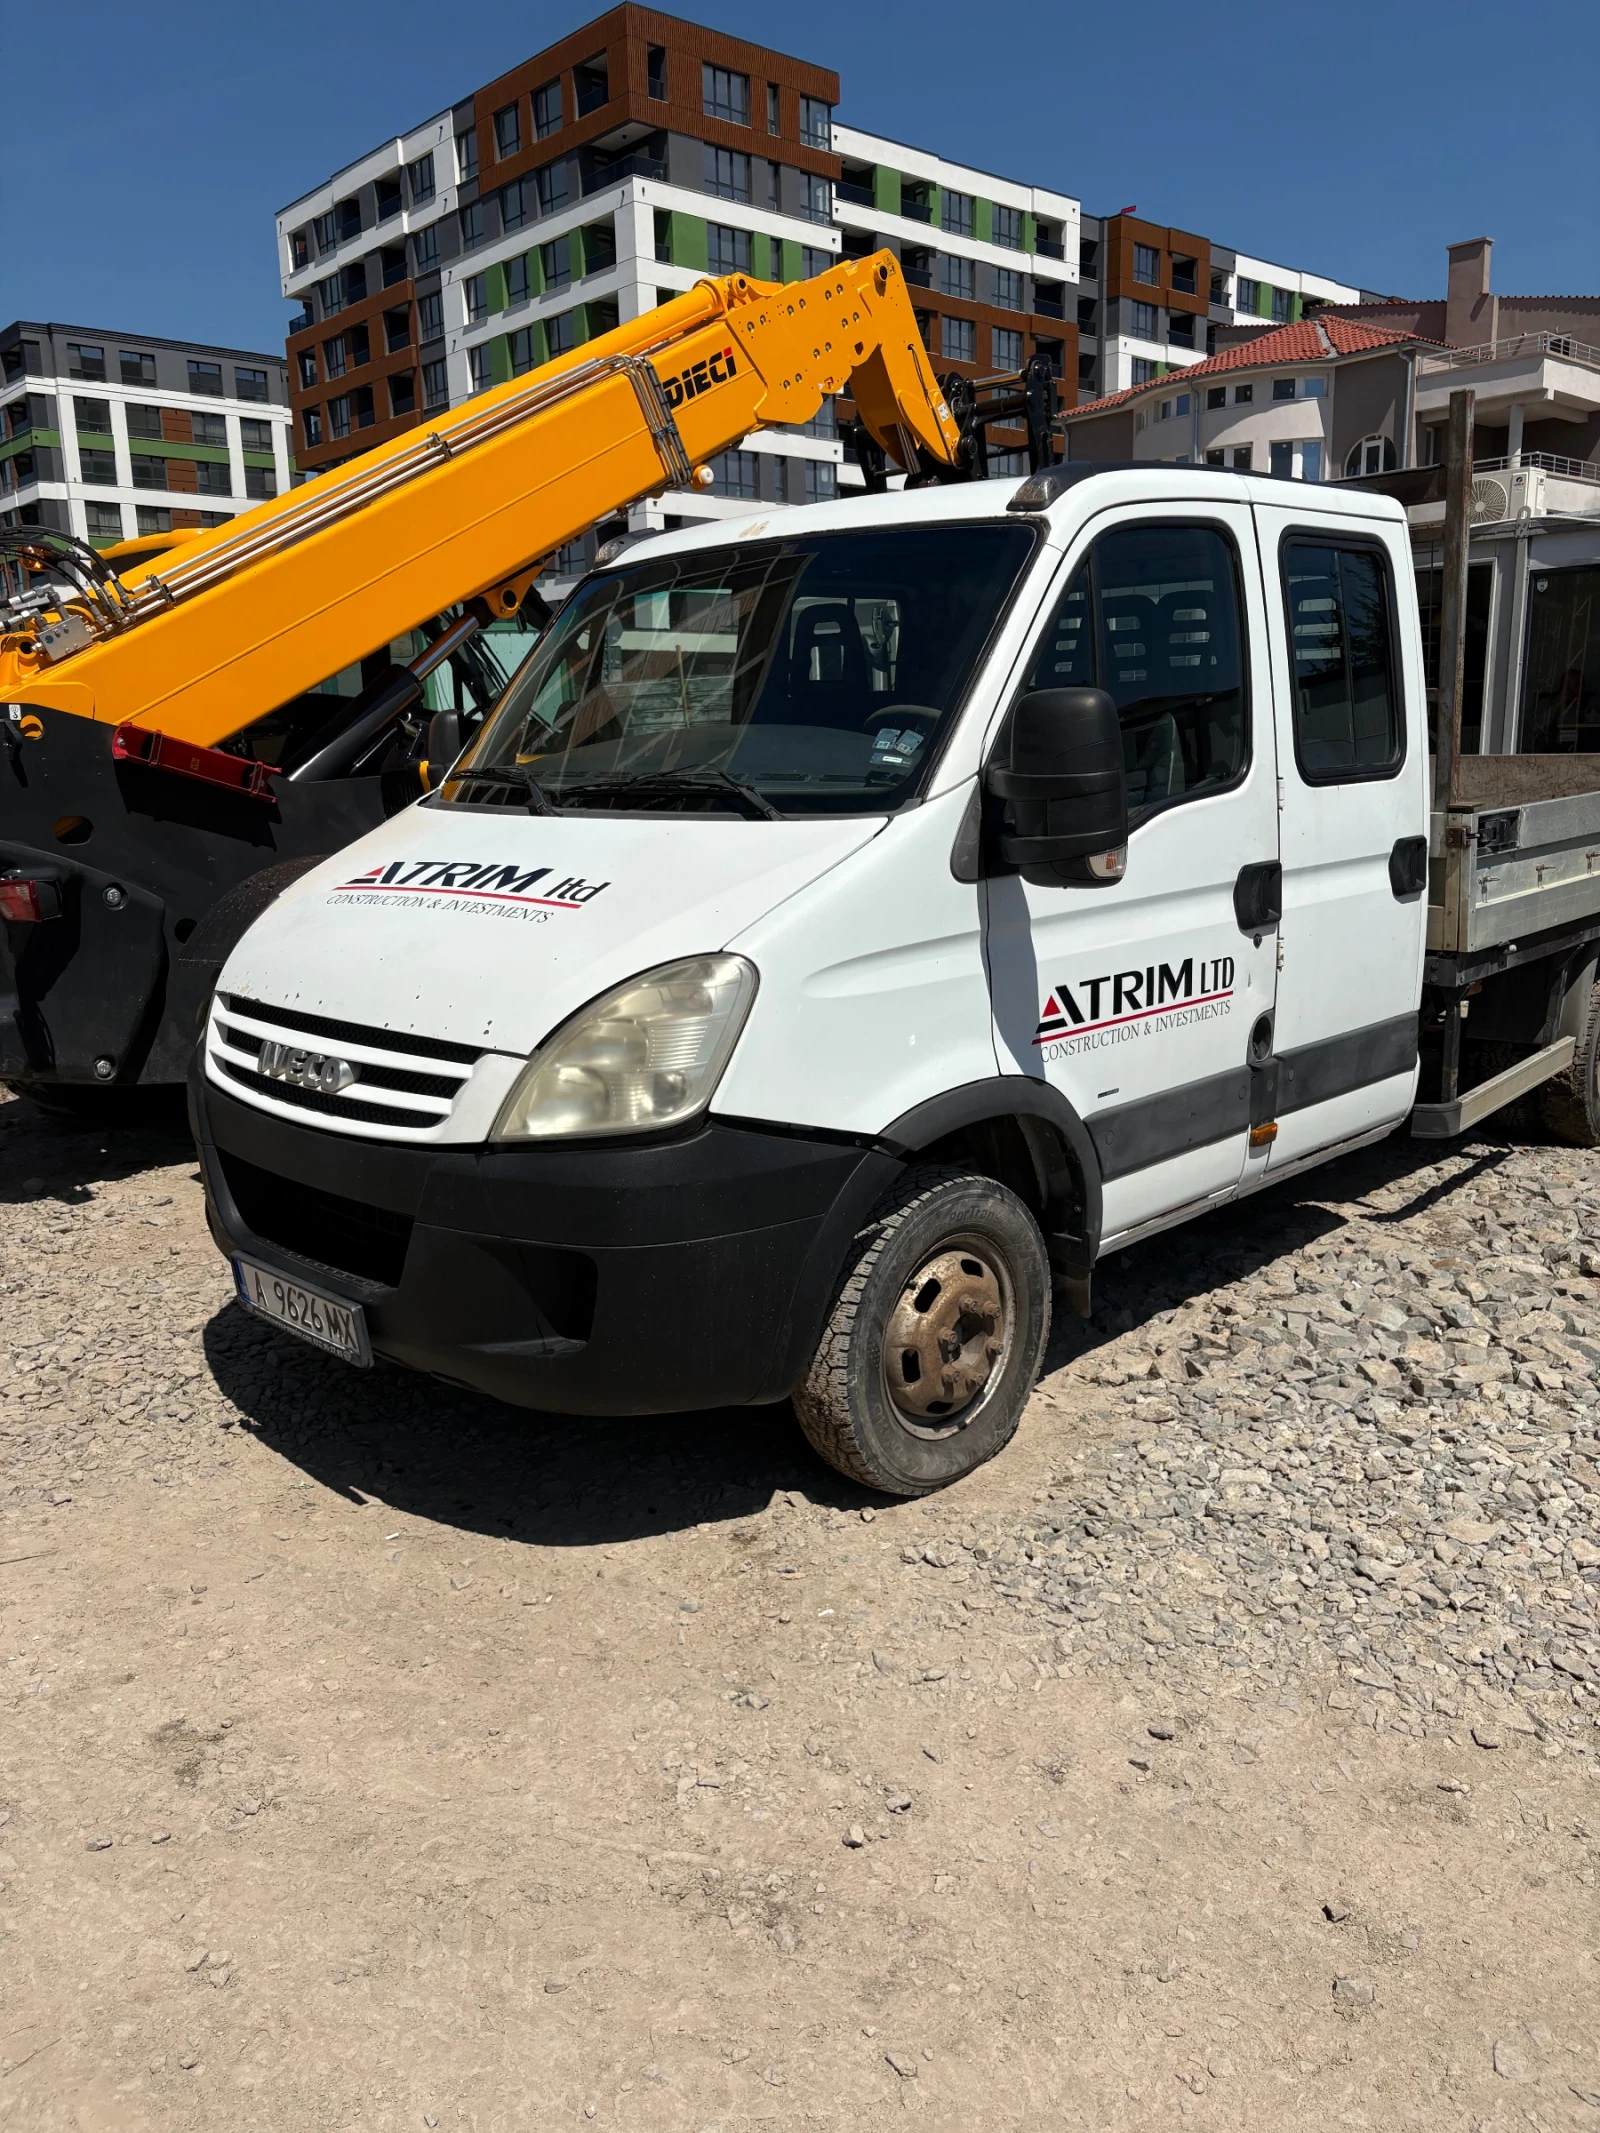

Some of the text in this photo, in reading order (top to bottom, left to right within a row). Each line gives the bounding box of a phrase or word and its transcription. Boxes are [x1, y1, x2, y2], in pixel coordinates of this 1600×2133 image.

[326, 894, 554, 924] CONSTRUCTION & INVESTMENTS
[345, 861, 611, 903] ATRIM ltd
[1035, 956, 1235, 1035] ATRIM LTD
[1041, 999, 1231, 1063] CONSTRUCTION & INVESTMENTS
[257, 1040, 349, 1093] IVECO
[254, 1271, 269, 1308] A
[273, 1281, 324, 1333] 9626
[323, 1303, 357, 1350] MX
